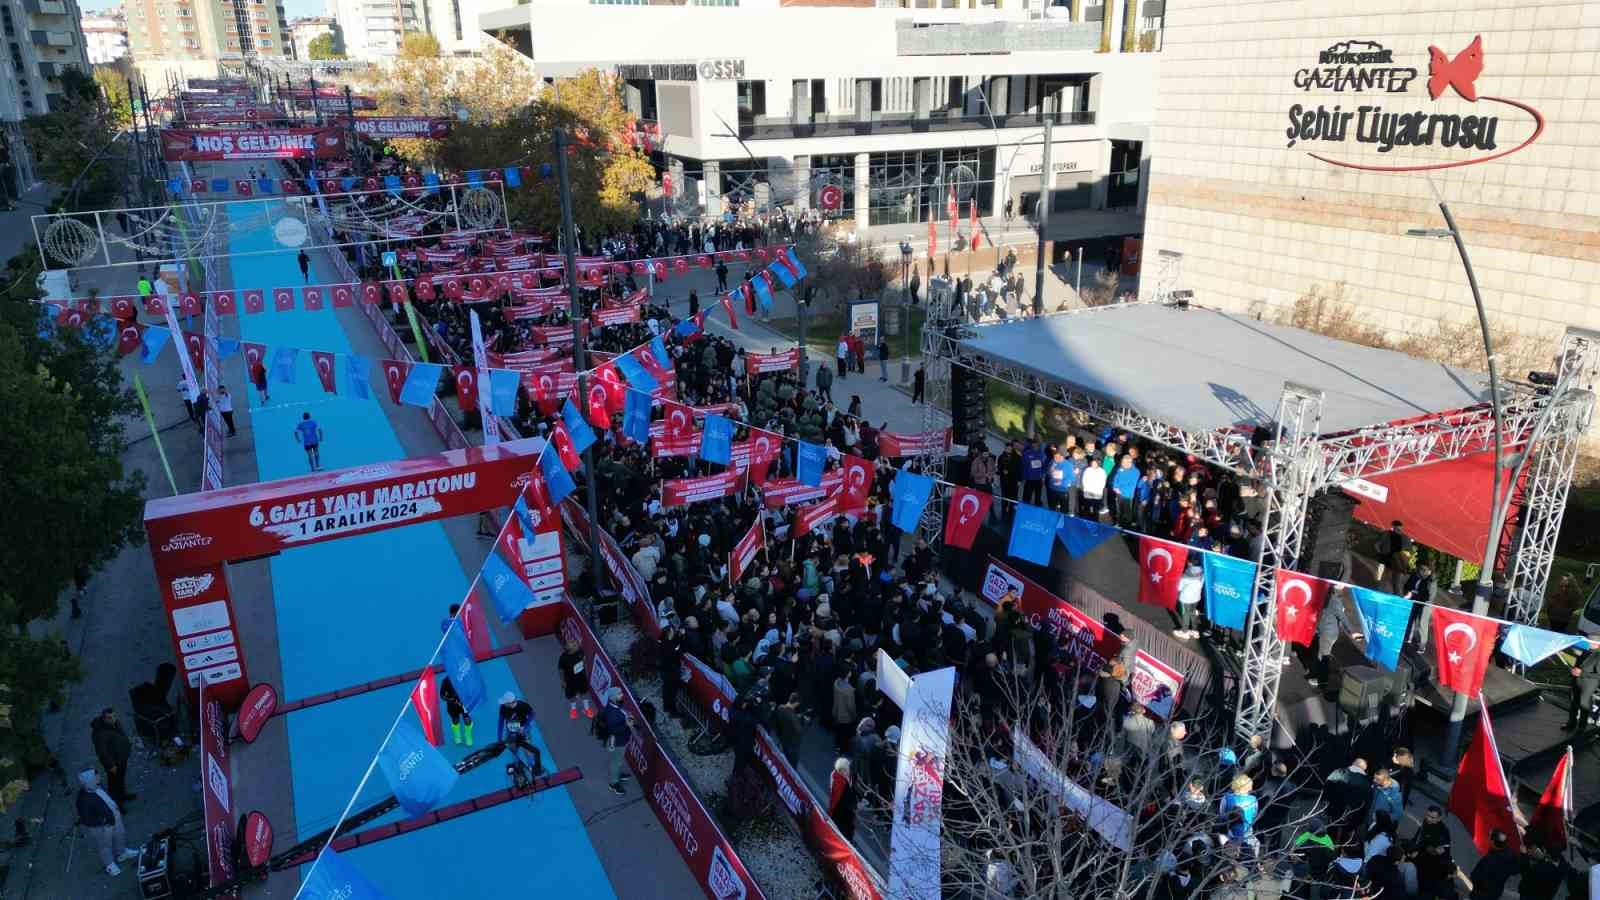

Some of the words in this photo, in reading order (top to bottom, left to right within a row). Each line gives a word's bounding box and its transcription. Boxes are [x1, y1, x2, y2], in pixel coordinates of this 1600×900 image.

[196, 136, 234, 153] HOŞ
[238, 134, 314, 151] GELDİNİZ
[1287, 104, 1353, 148] Şehir
[1356, 106, 1498, 152] Tiyatrosu
[322, 490, 368, 515] YARI
[373, 471, 477, 507] MARATONU
[299, 522, 307, 536] 1
[313, 510, 376, 533] ARALIK
[381, 502, 418, 521] 2024
